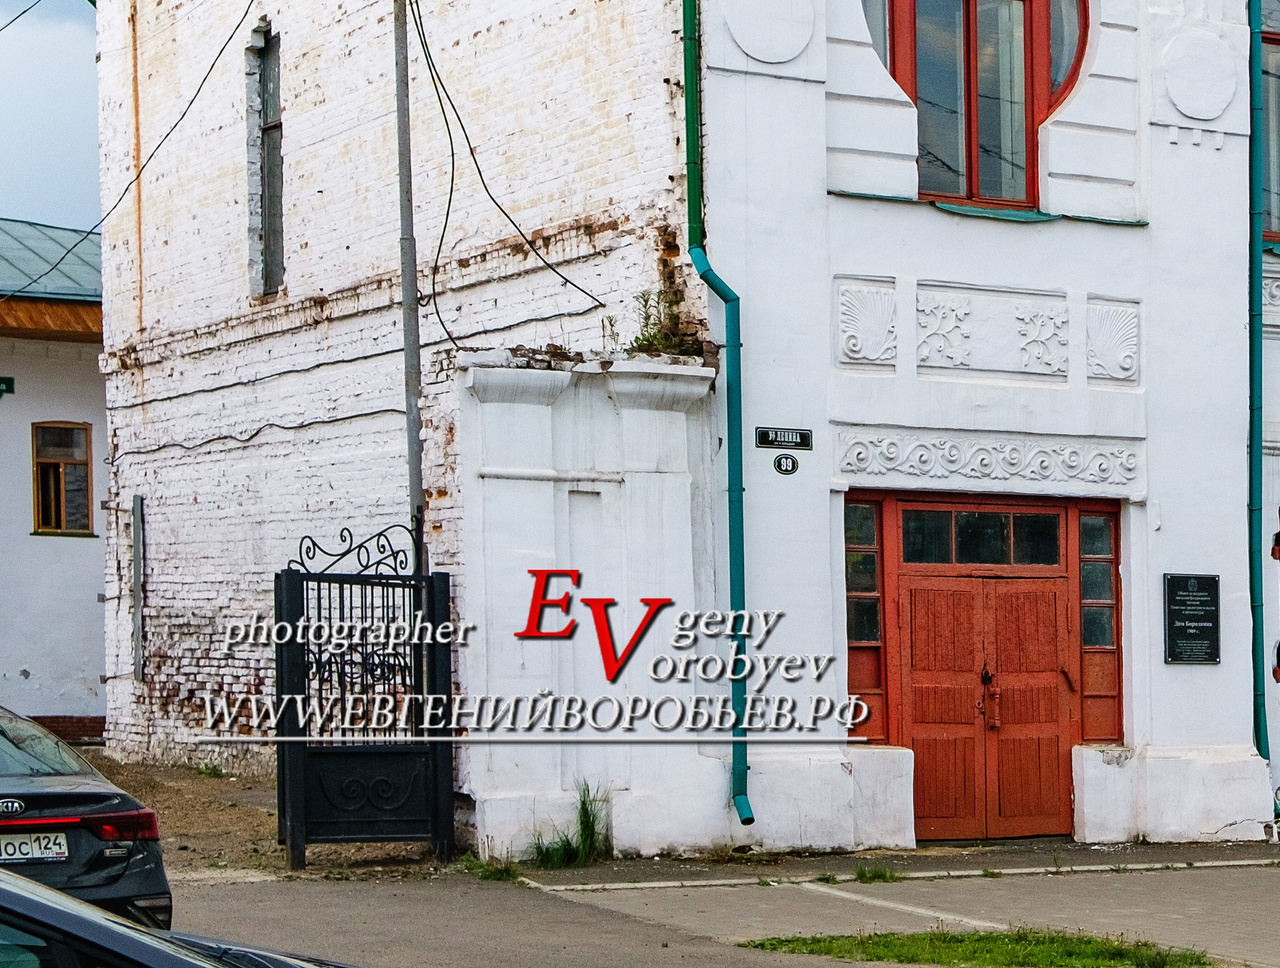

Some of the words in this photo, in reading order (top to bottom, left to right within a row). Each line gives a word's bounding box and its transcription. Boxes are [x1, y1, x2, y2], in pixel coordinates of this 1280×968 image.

[781, 458, 792, 470] 99
[0, 802, 20, 812] KIA
[33, 835, 62, 851] 124
